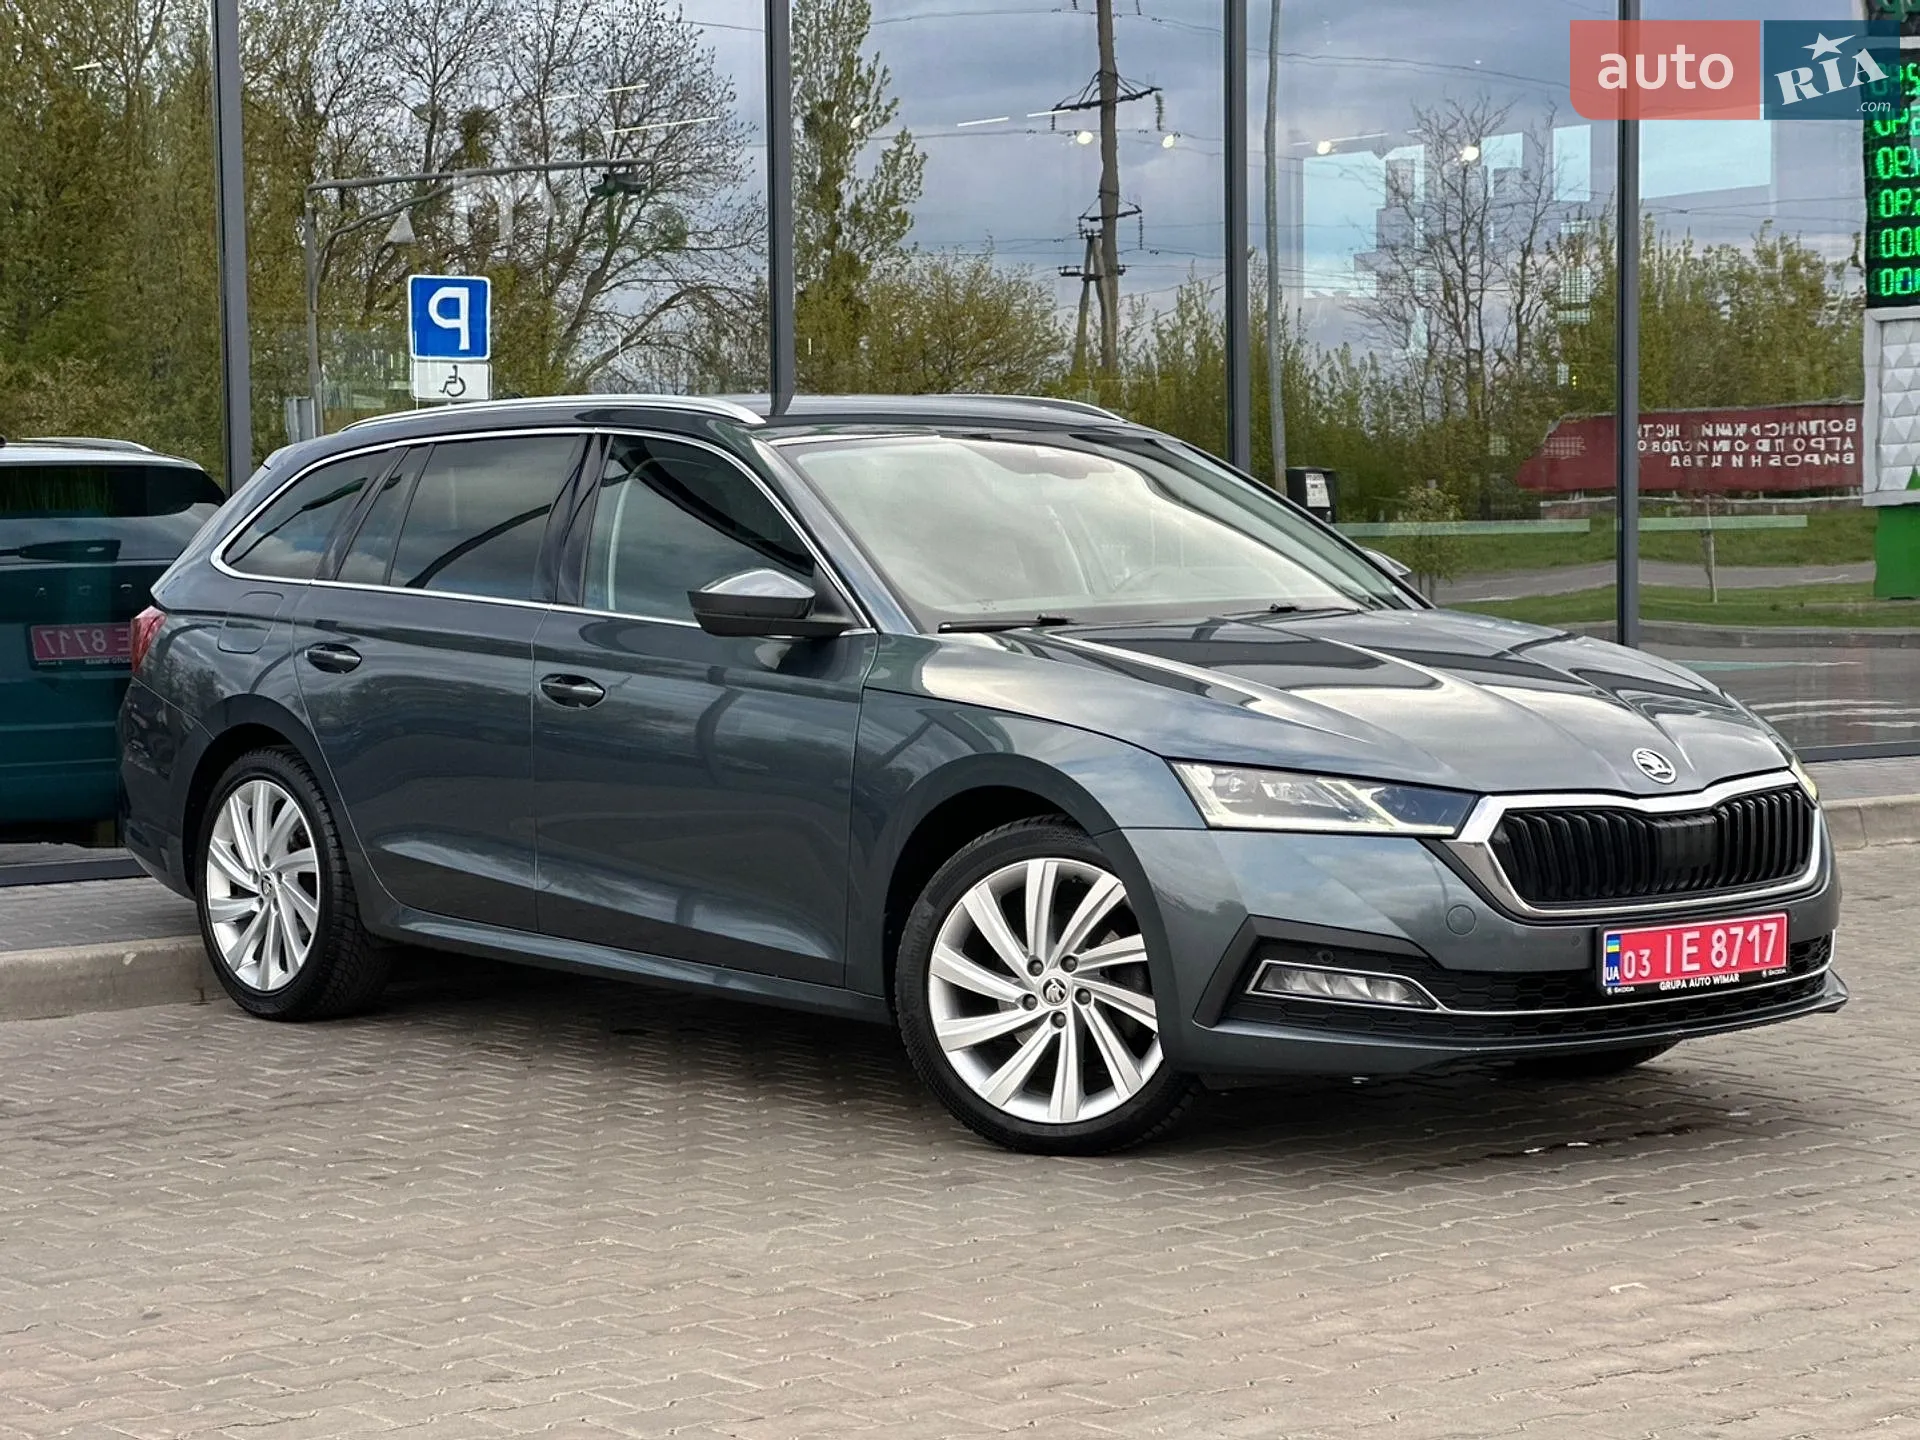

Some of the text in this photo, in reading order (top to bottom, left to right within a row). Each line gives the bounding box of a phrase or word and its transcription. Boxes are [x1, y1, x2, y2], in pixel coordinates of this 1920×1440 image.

[1623, 922, 1778, 980] 03 IE 8717
[1606, 966, 1620, 981] UA
[1659, 973, 1740, 991] GRUPA AUTO WIMAR
